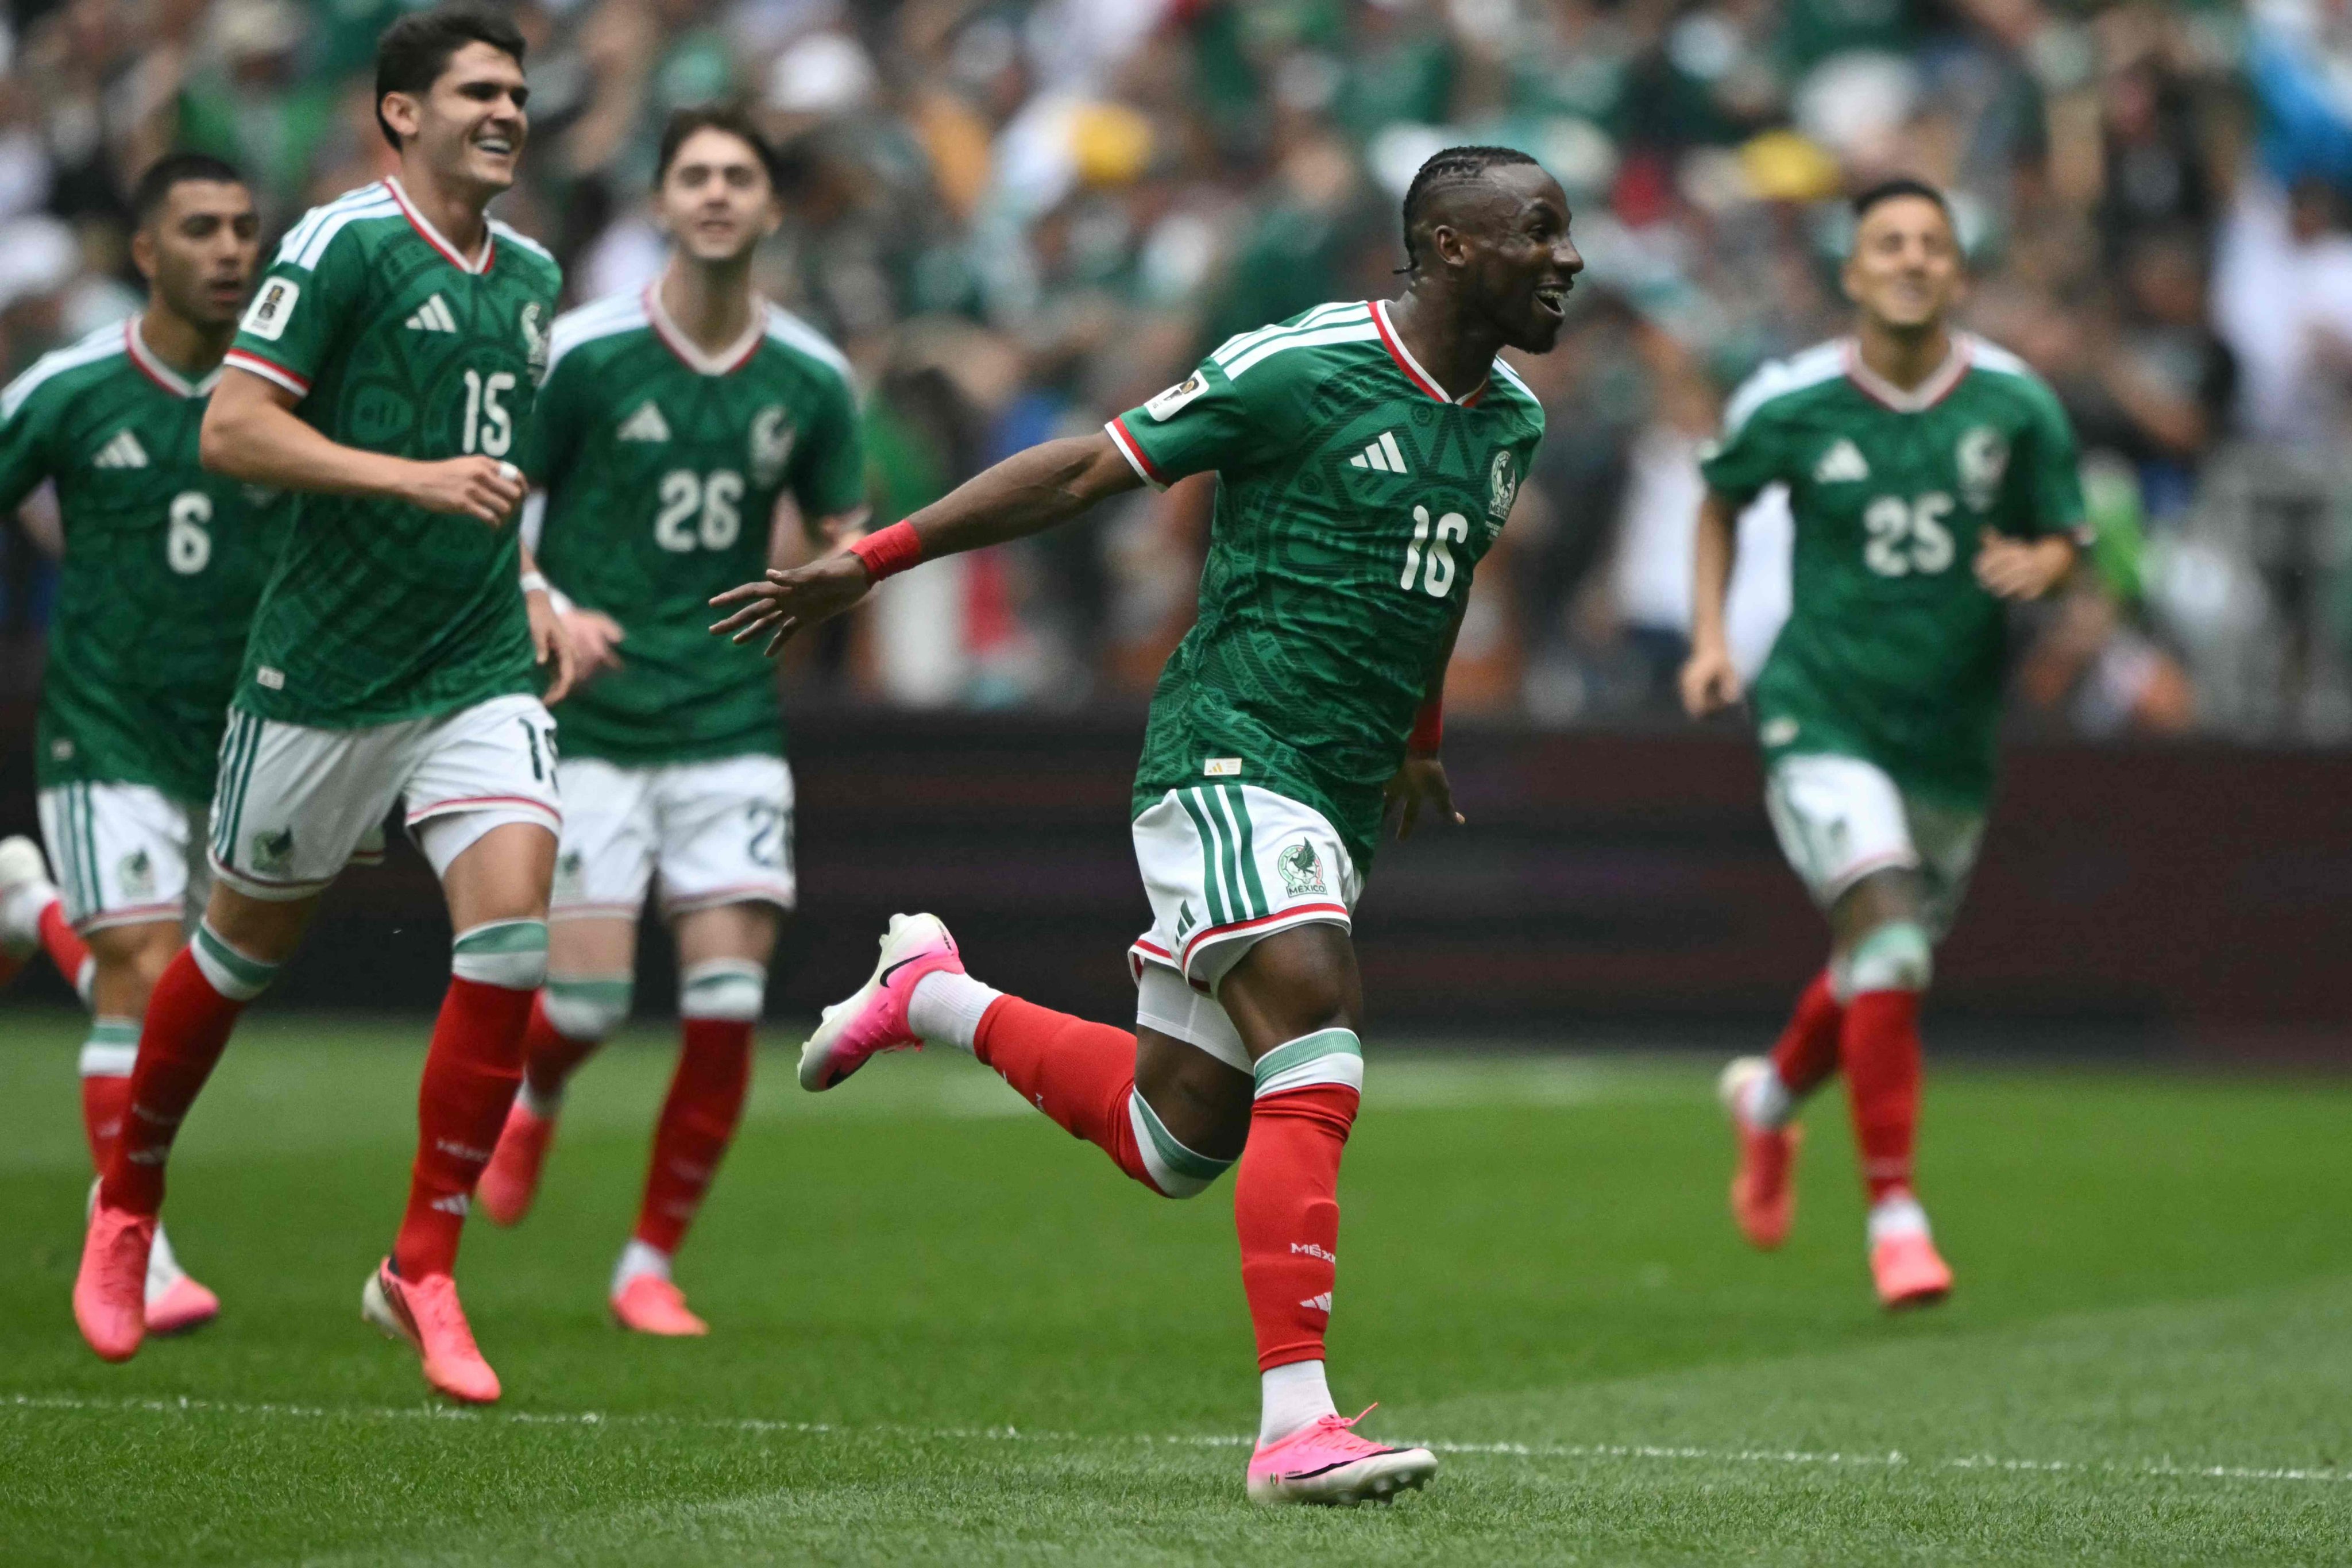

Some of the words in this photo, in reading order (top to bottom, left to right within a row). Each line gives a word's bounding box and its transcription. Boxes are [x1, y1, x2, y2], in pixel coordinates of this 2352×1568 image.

[464, 369, 516, 456] 15
[168, 492, 212, 574] 6
[656, 469, 744, 551] 26
[1400, 505, 1468, 597] 16
[1865, 491, 1955, 576] 25
